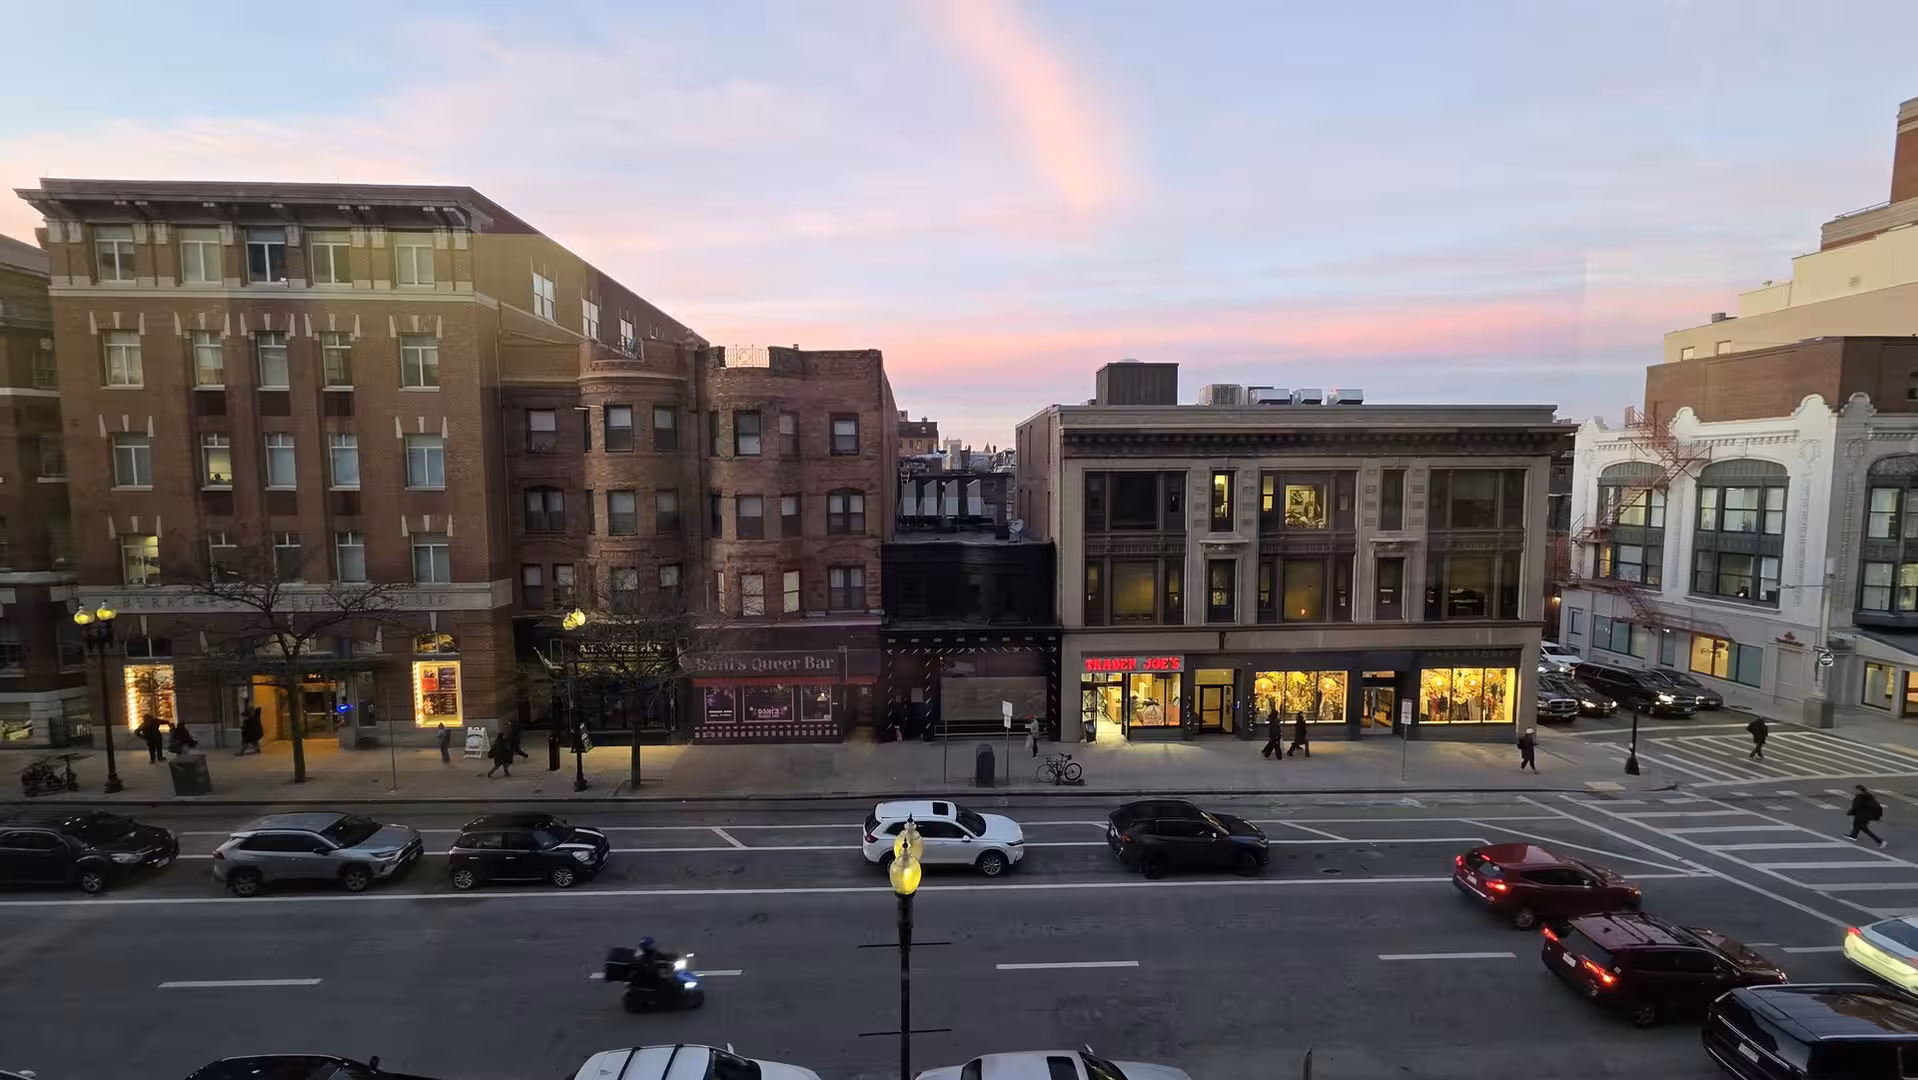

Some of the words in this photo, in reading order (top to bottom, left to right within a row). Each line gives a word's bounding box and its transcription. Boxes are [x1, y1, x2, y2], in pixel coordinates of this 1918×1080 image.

[695, 656, 746, 671] Dani's
[752, 656, 800, 672] Queer
[804, 655, 833, 670] Bar
[1084, 657, 1137, 672] TRADER
[1143, 657, 1180, 671] JOE'S
